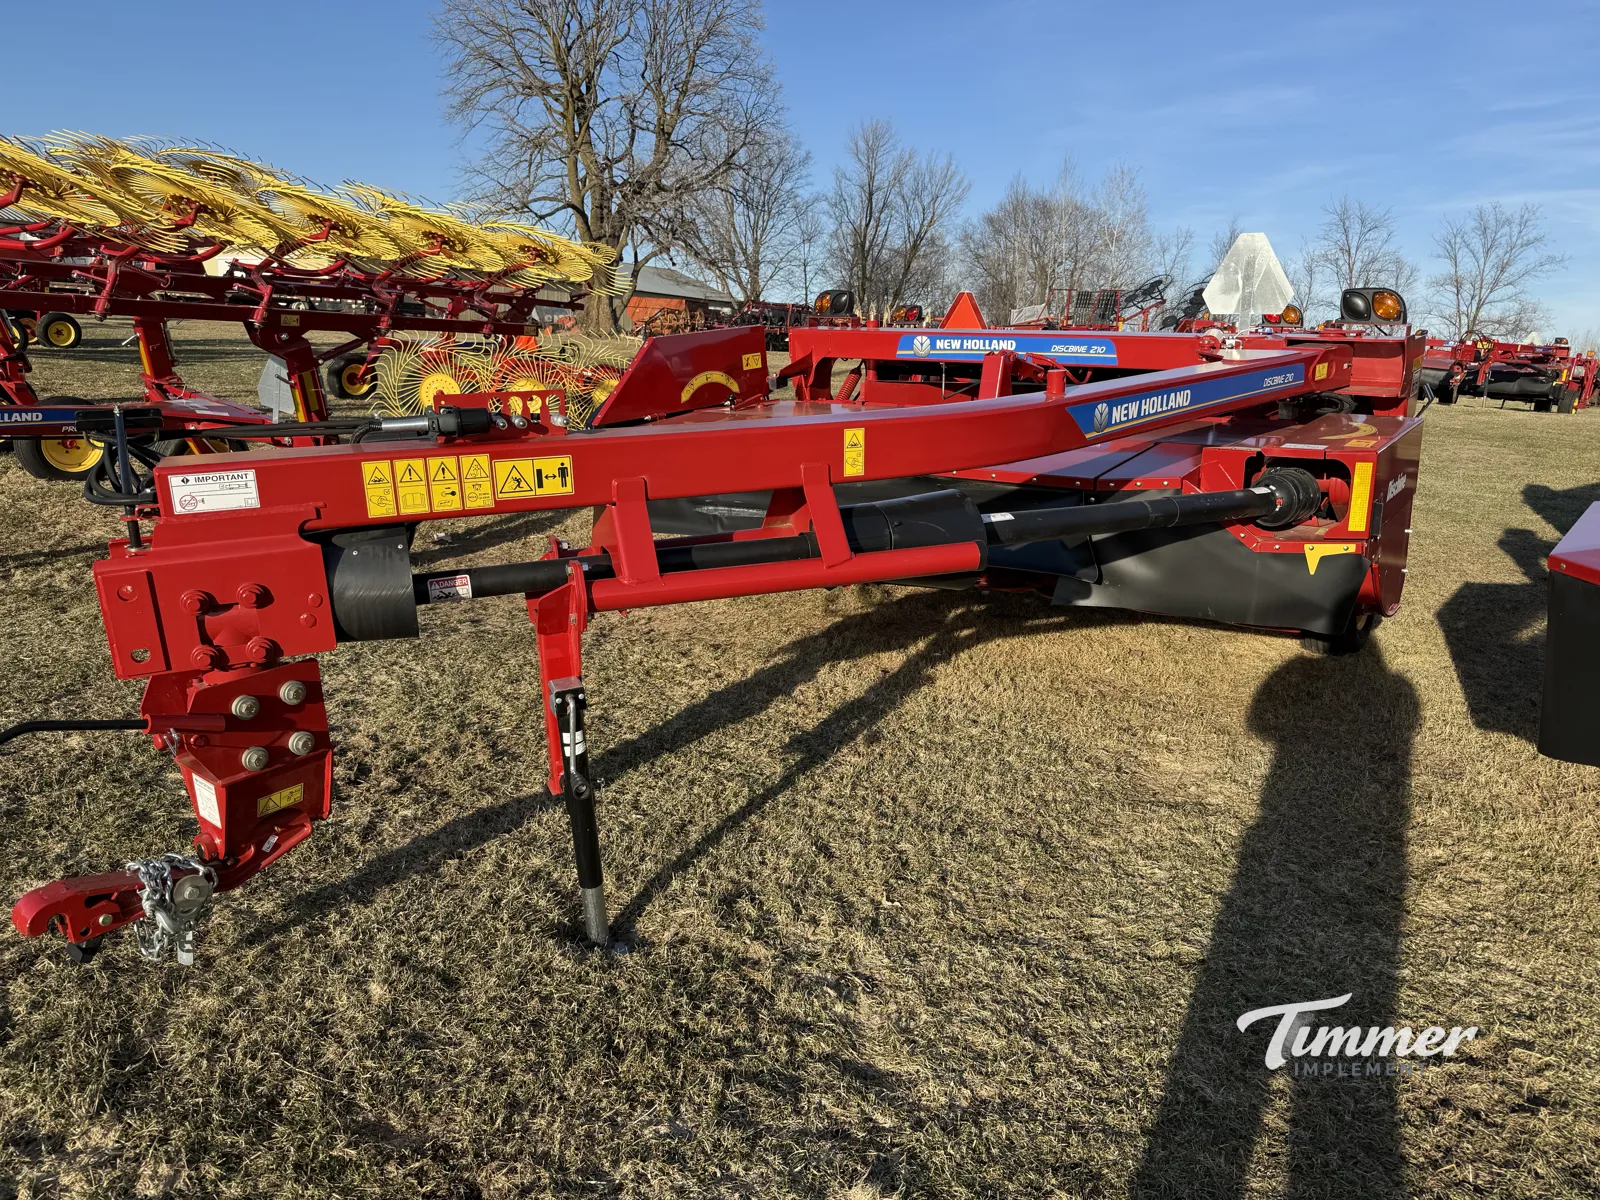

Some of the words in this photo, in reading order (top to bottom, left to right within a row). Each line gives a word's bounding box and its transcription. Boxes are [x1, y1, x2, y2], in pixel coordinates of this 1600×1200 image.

[936, 339, 963, 350] NEW
[963, 339, 1016, 351] HOLLAND
[1051, 344, 1088, 353] DISCBINE
[1090, 345, 1106, 354] 210
[1263, 374, 1285, 388] DISCBINE
[1111, 400, 1140, 425] NEW
[1140, 389, 1191, 417] HOLLAND
[194, 473, 249, 484] IMPORTANT
[439, 577, 468, 588] DANGER
